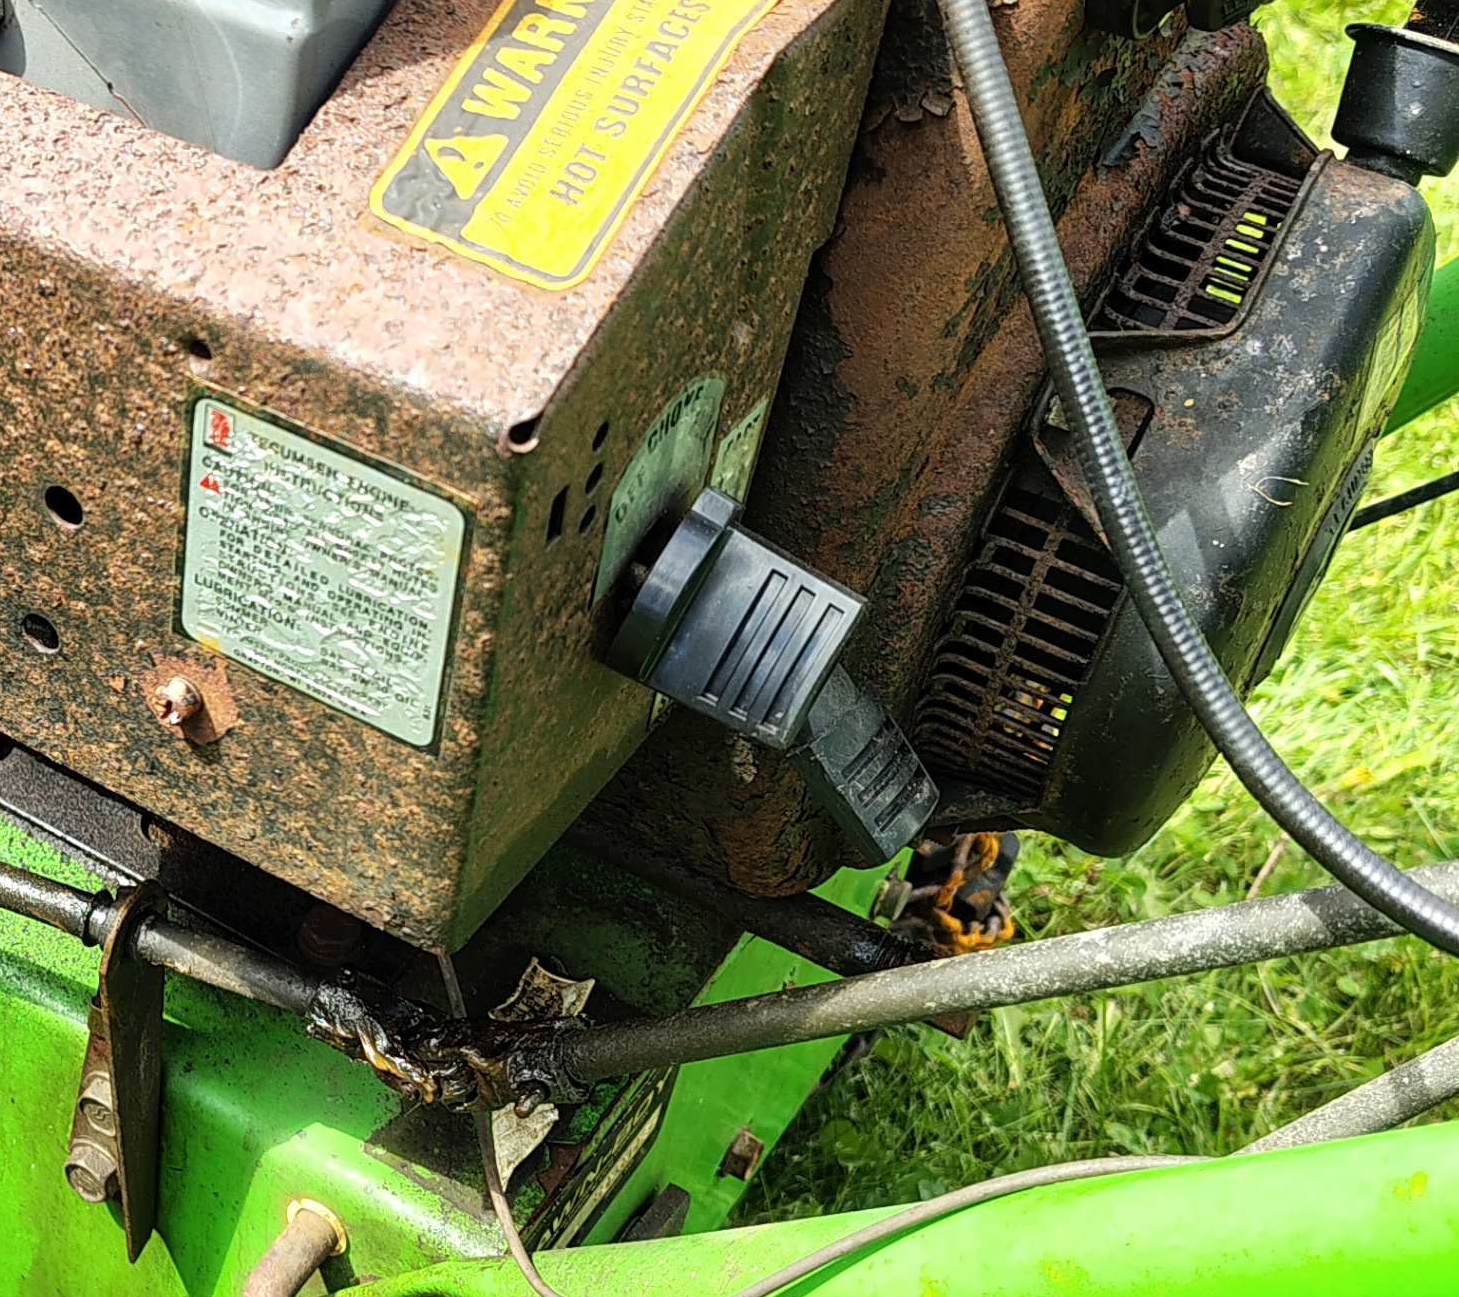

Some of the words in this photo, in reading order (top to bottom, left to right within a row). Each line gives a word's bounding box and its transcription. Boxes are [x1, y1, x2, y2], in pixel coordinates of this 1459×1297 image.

[506, 161, 547, 210] AVOID
[537, 88, 594, 159] SERIOUS
[585, 25, 634, 86] INJURY
[549, 142, 607, 207] HOT
[193, 571, 304, 634] LUBRICATION:
[218, 527, 245, 549] FOR
[251, 542, 330, 587] DETAILED
[336, 581, 433, 634] LUBRICATION,
[281, 588, 337, 623] MANUAL
[292, 572, 320, 593] AND
[326, 588, 404, 632] OPERATING
